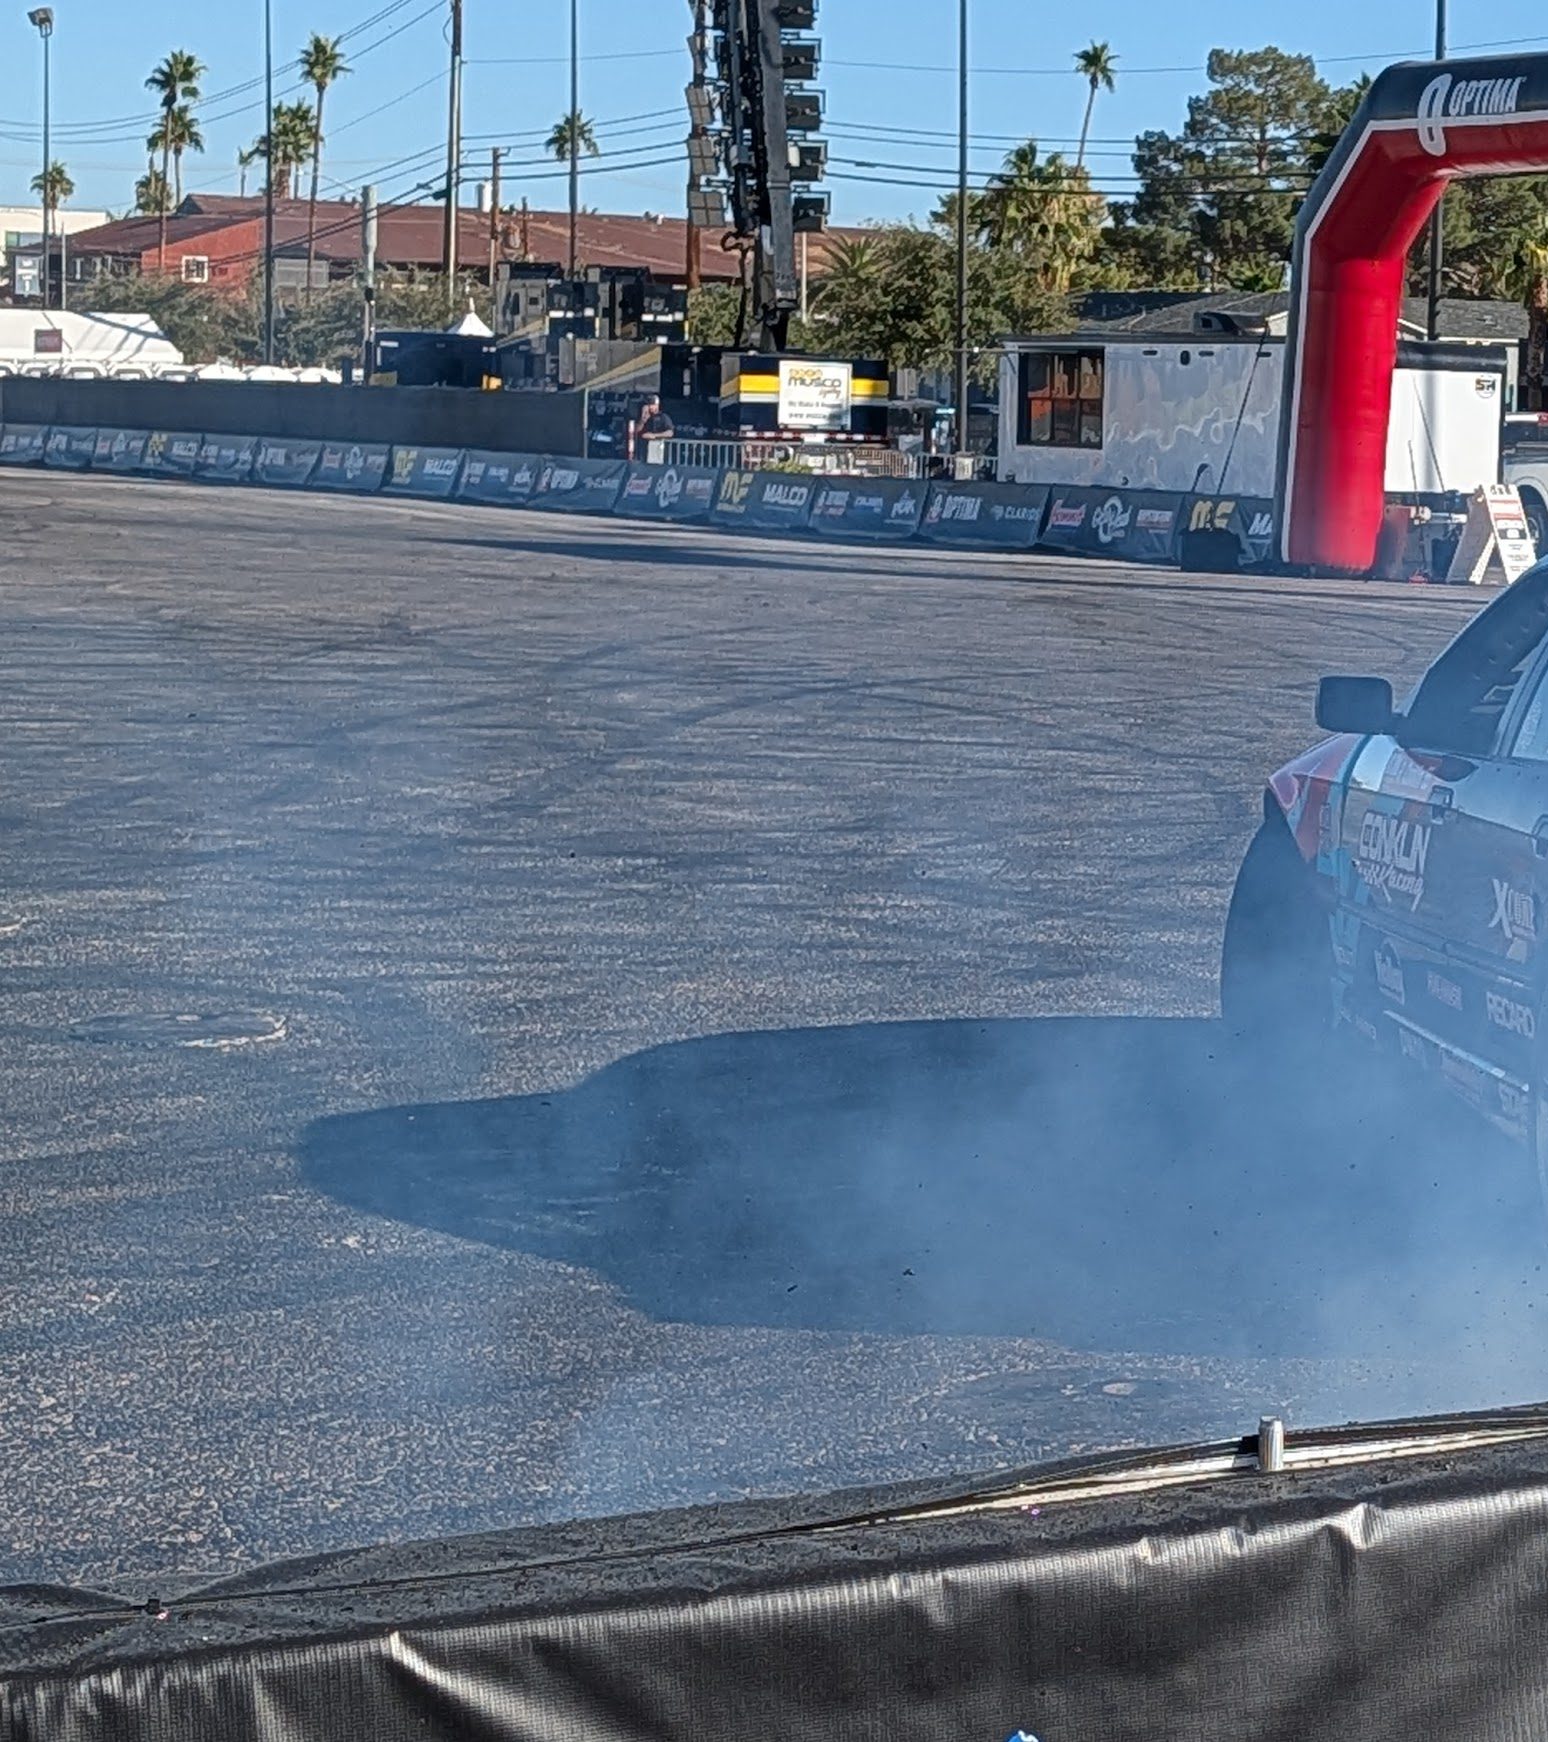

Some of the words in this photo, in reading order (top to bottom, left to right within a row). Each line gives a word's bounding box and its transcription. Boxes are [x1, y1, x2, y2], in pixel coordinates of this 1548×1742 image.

[1449, 77, 1522, 116] OPTIMA
[762, 483, 808, 506] MALCO
[1486, 991, 1536, 1039] RECARO
